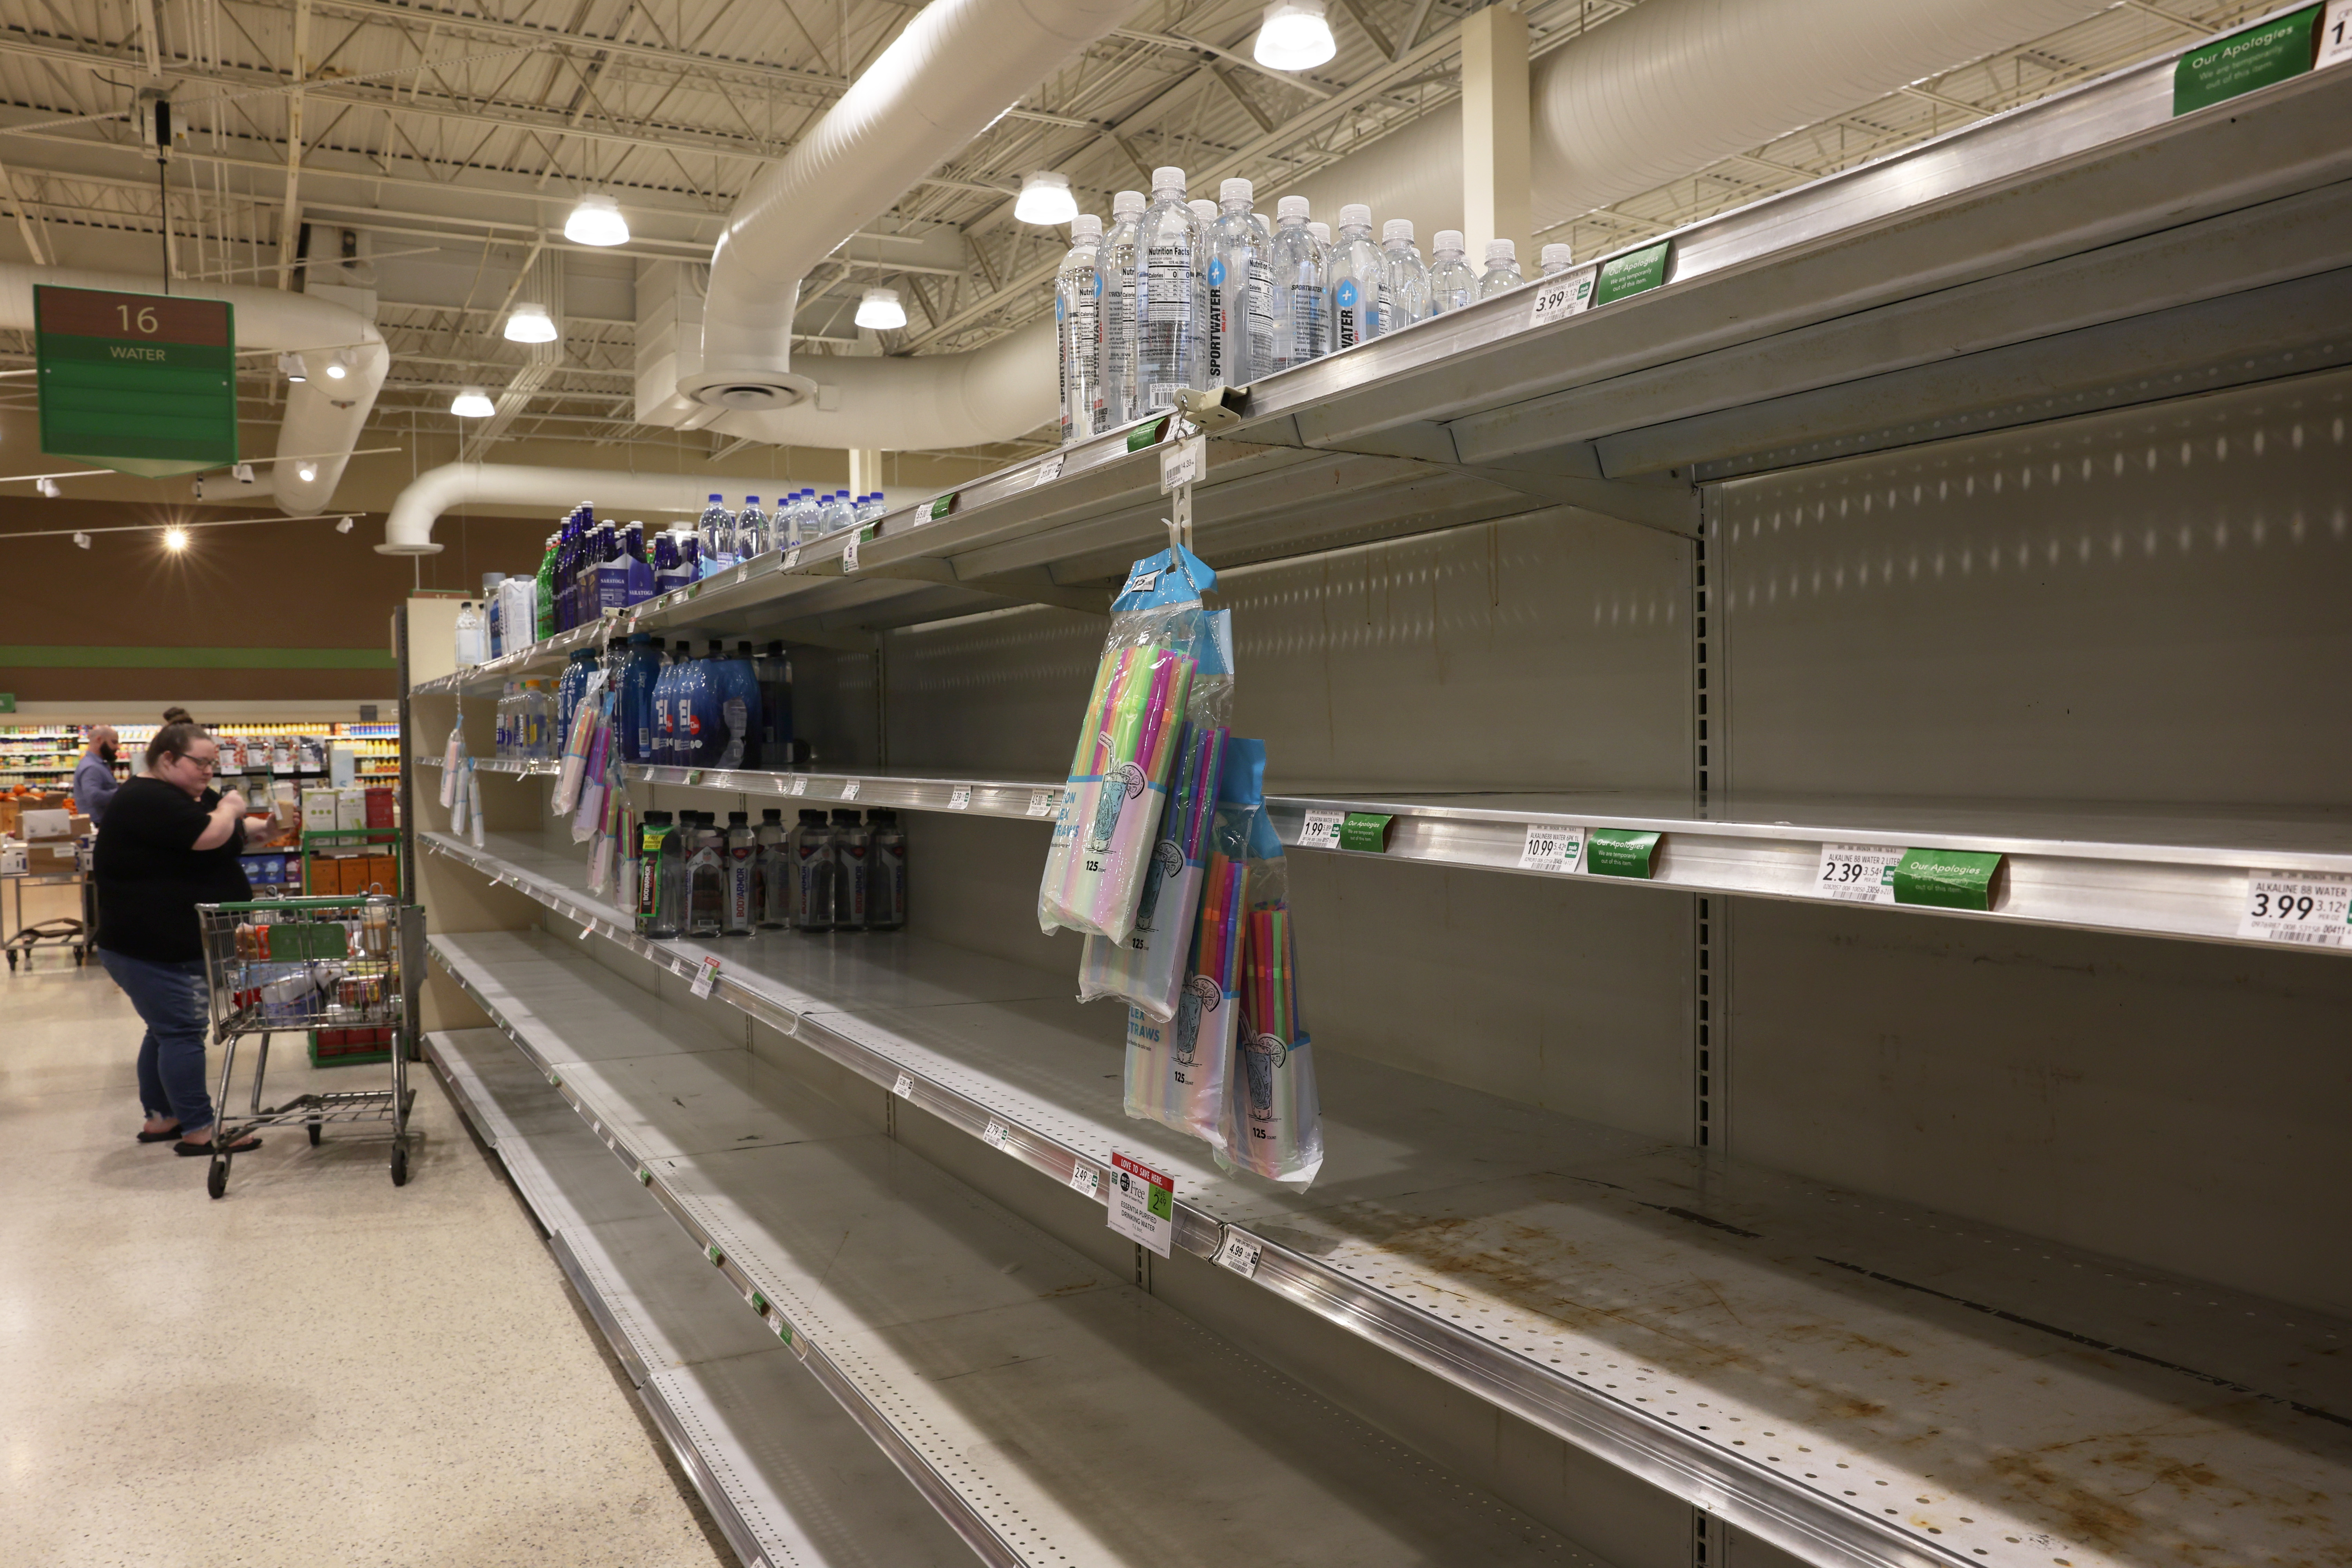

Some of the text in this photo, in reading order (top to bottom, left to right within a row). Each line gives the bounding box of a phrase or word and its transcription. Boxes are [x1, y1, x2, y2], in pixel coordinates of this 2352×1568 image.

[2192, 26, 2293, 69] Our Apologies
[1250, 260, 1267, 270] Nutrition
[1624, 256, 1659, 272] Apologies
[1627, 267, 1652, 279] temporarily
[1553, 283, 1566, 293] SPRING
[1568, 279, 1581, 288] WATER
[1536, 291, 1564, 312] 3.99
[117, 305, 158, 333] 16
[1210, 289, 1220, 376] SPORTWATER
[1341, 310, 1352, 348] WATER
[110, 347, 165, 361] WATER
[1208, 377, 1224, 390] 234
[952, 792, 961, 801] 2.39
[1305, 822, 1323, 836] 1.99
[1528, 840, 1553, 856] 10.99
[1610, 841, 1644, 850] Apologies
[1829, 854, 1852, 862] ALKALINE
[1086, 861, 1099, 871] 125
[1823, 862, 1862, 882] 2.39
[1931, 864, 1980, 875] Apologies
[2256, 883, 2347, 897] ALKALINE 88 WATER
[2251, 893, 2314, 920] 3.99
[1132, 938, 1143, 949] 125
[1175, 1071, 1185, 1083] 125
[987, 1124, 998, 1135] 2.79
[1253, 1127, 1266, 1139] 125
[1075, 1167, 1087, 1181] 2.49
[1121, 1159, 1163, 1186] LOVE TO SAVE HERE.
[1131, 1180, 1145, 1200] Free
[1155, 1188, 1165, 1198] SAVE
[1121, 1201, 1138, 1214] ESSENTIA
[1140, 1211, 1156, 1224] PURIFIED
[1122, 1210, 1140, 1225] DRINKING
[1141, 1220, 1155, 1232] WATER
[1230, 1244, 1243, 1257] 4.99
